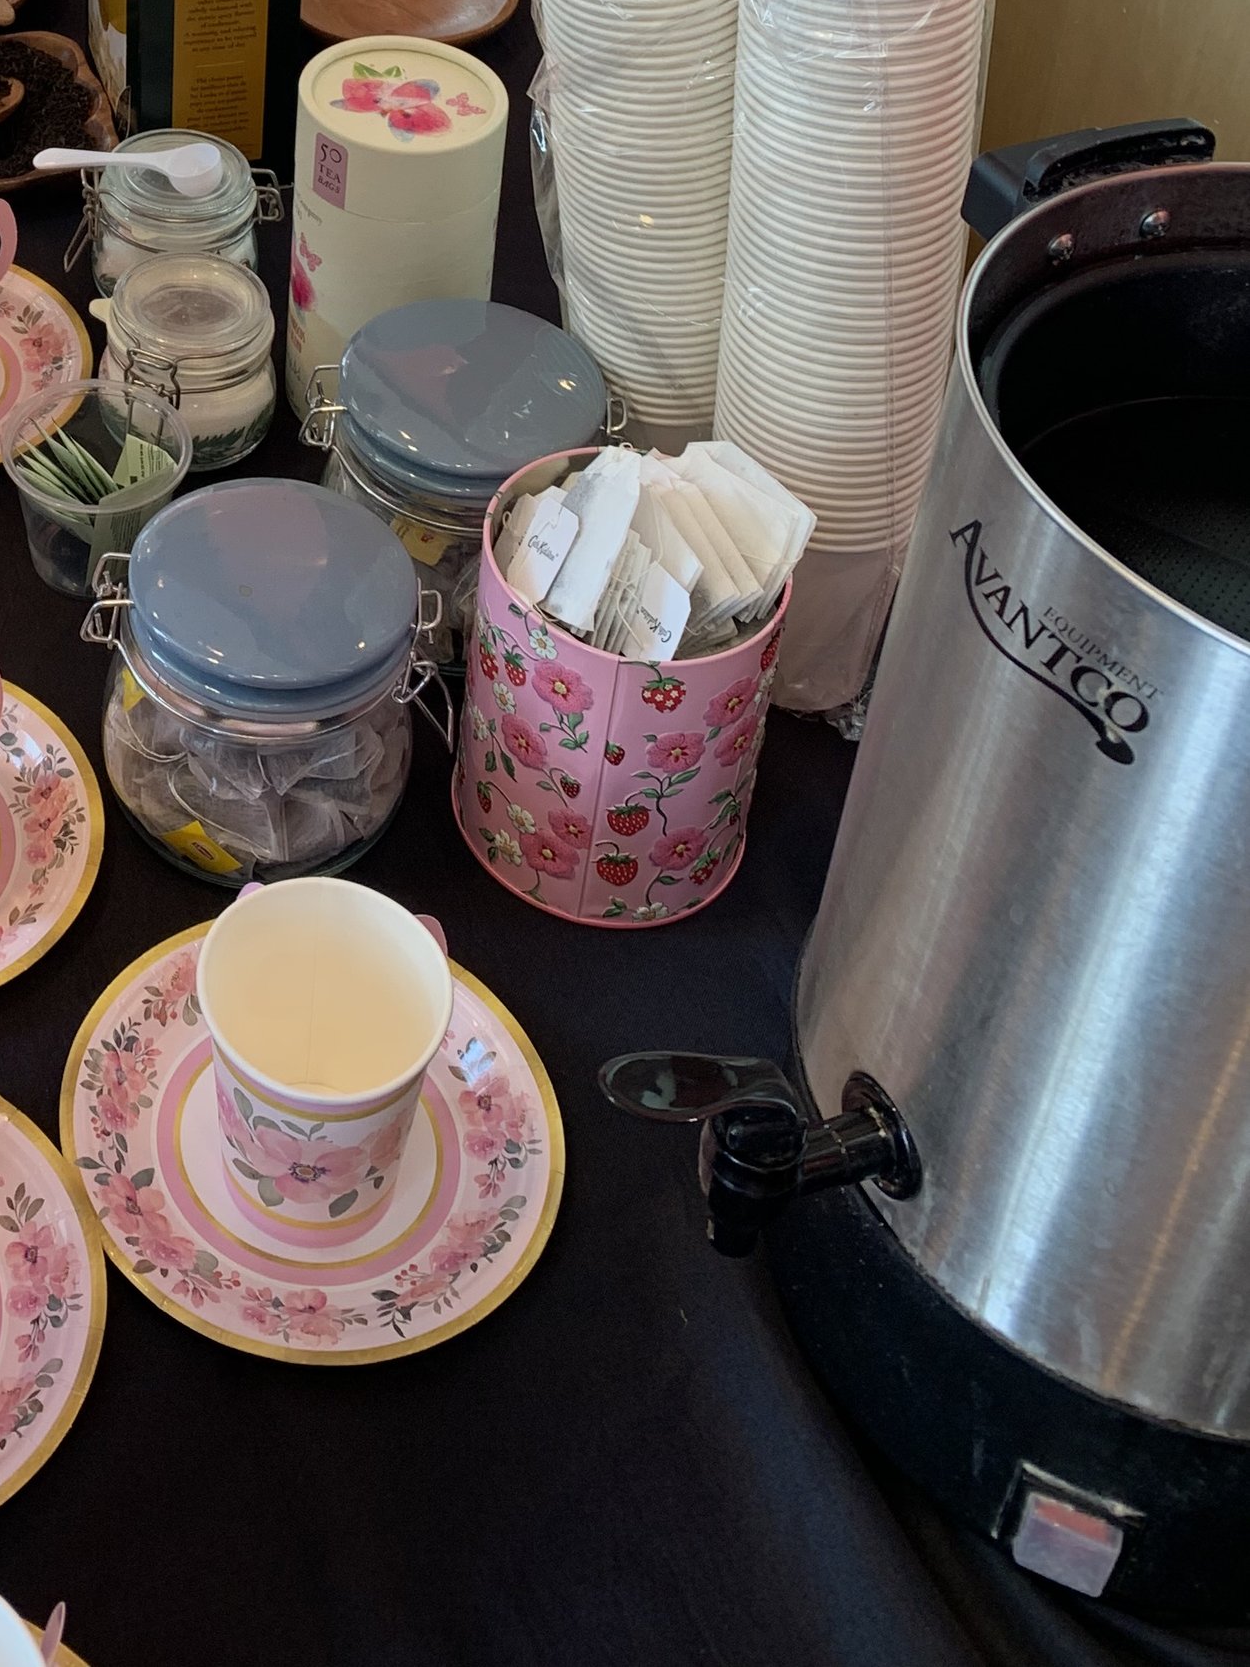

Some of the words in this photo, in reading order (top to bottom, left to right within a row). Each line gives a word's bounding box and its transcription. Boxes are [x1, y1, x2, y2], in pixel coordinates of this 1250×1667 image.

[320, 143, 343, 164] 50
[318, 162, 341, 184] TEA
[317, 175, 341, 194] BAGS
[949, 519, 1150, 734] AVANTCO
[1043, 606, 1163, 700] EQUIPMENT
